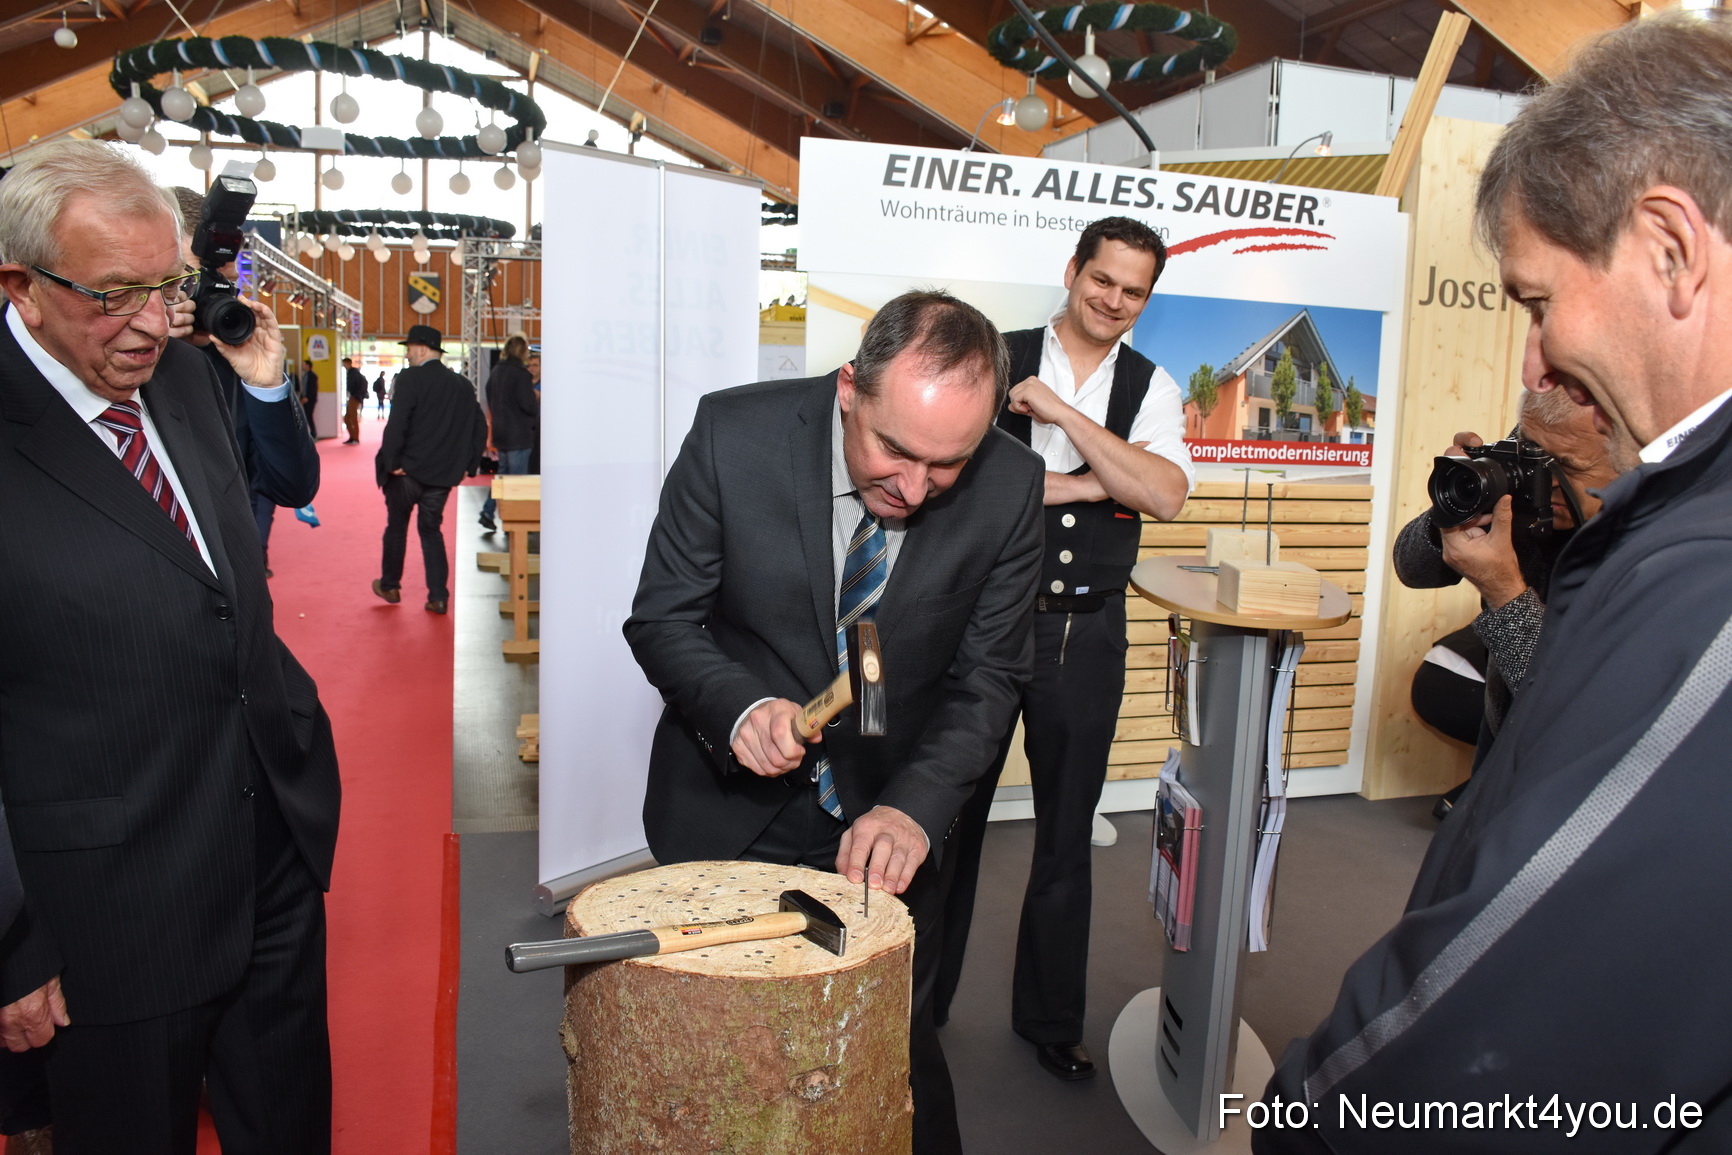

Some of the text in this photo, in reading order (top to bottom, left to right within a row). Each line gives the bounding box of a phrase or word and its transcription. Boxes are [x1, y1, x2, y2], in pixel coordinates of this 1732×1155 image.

[882, 153, 1021, 197] EINER.
[1031, 167, 1165, 210] ALLES.
[880, 199, 1008, 226] Wohnträume
[1013, 209, 1029, 228] in
